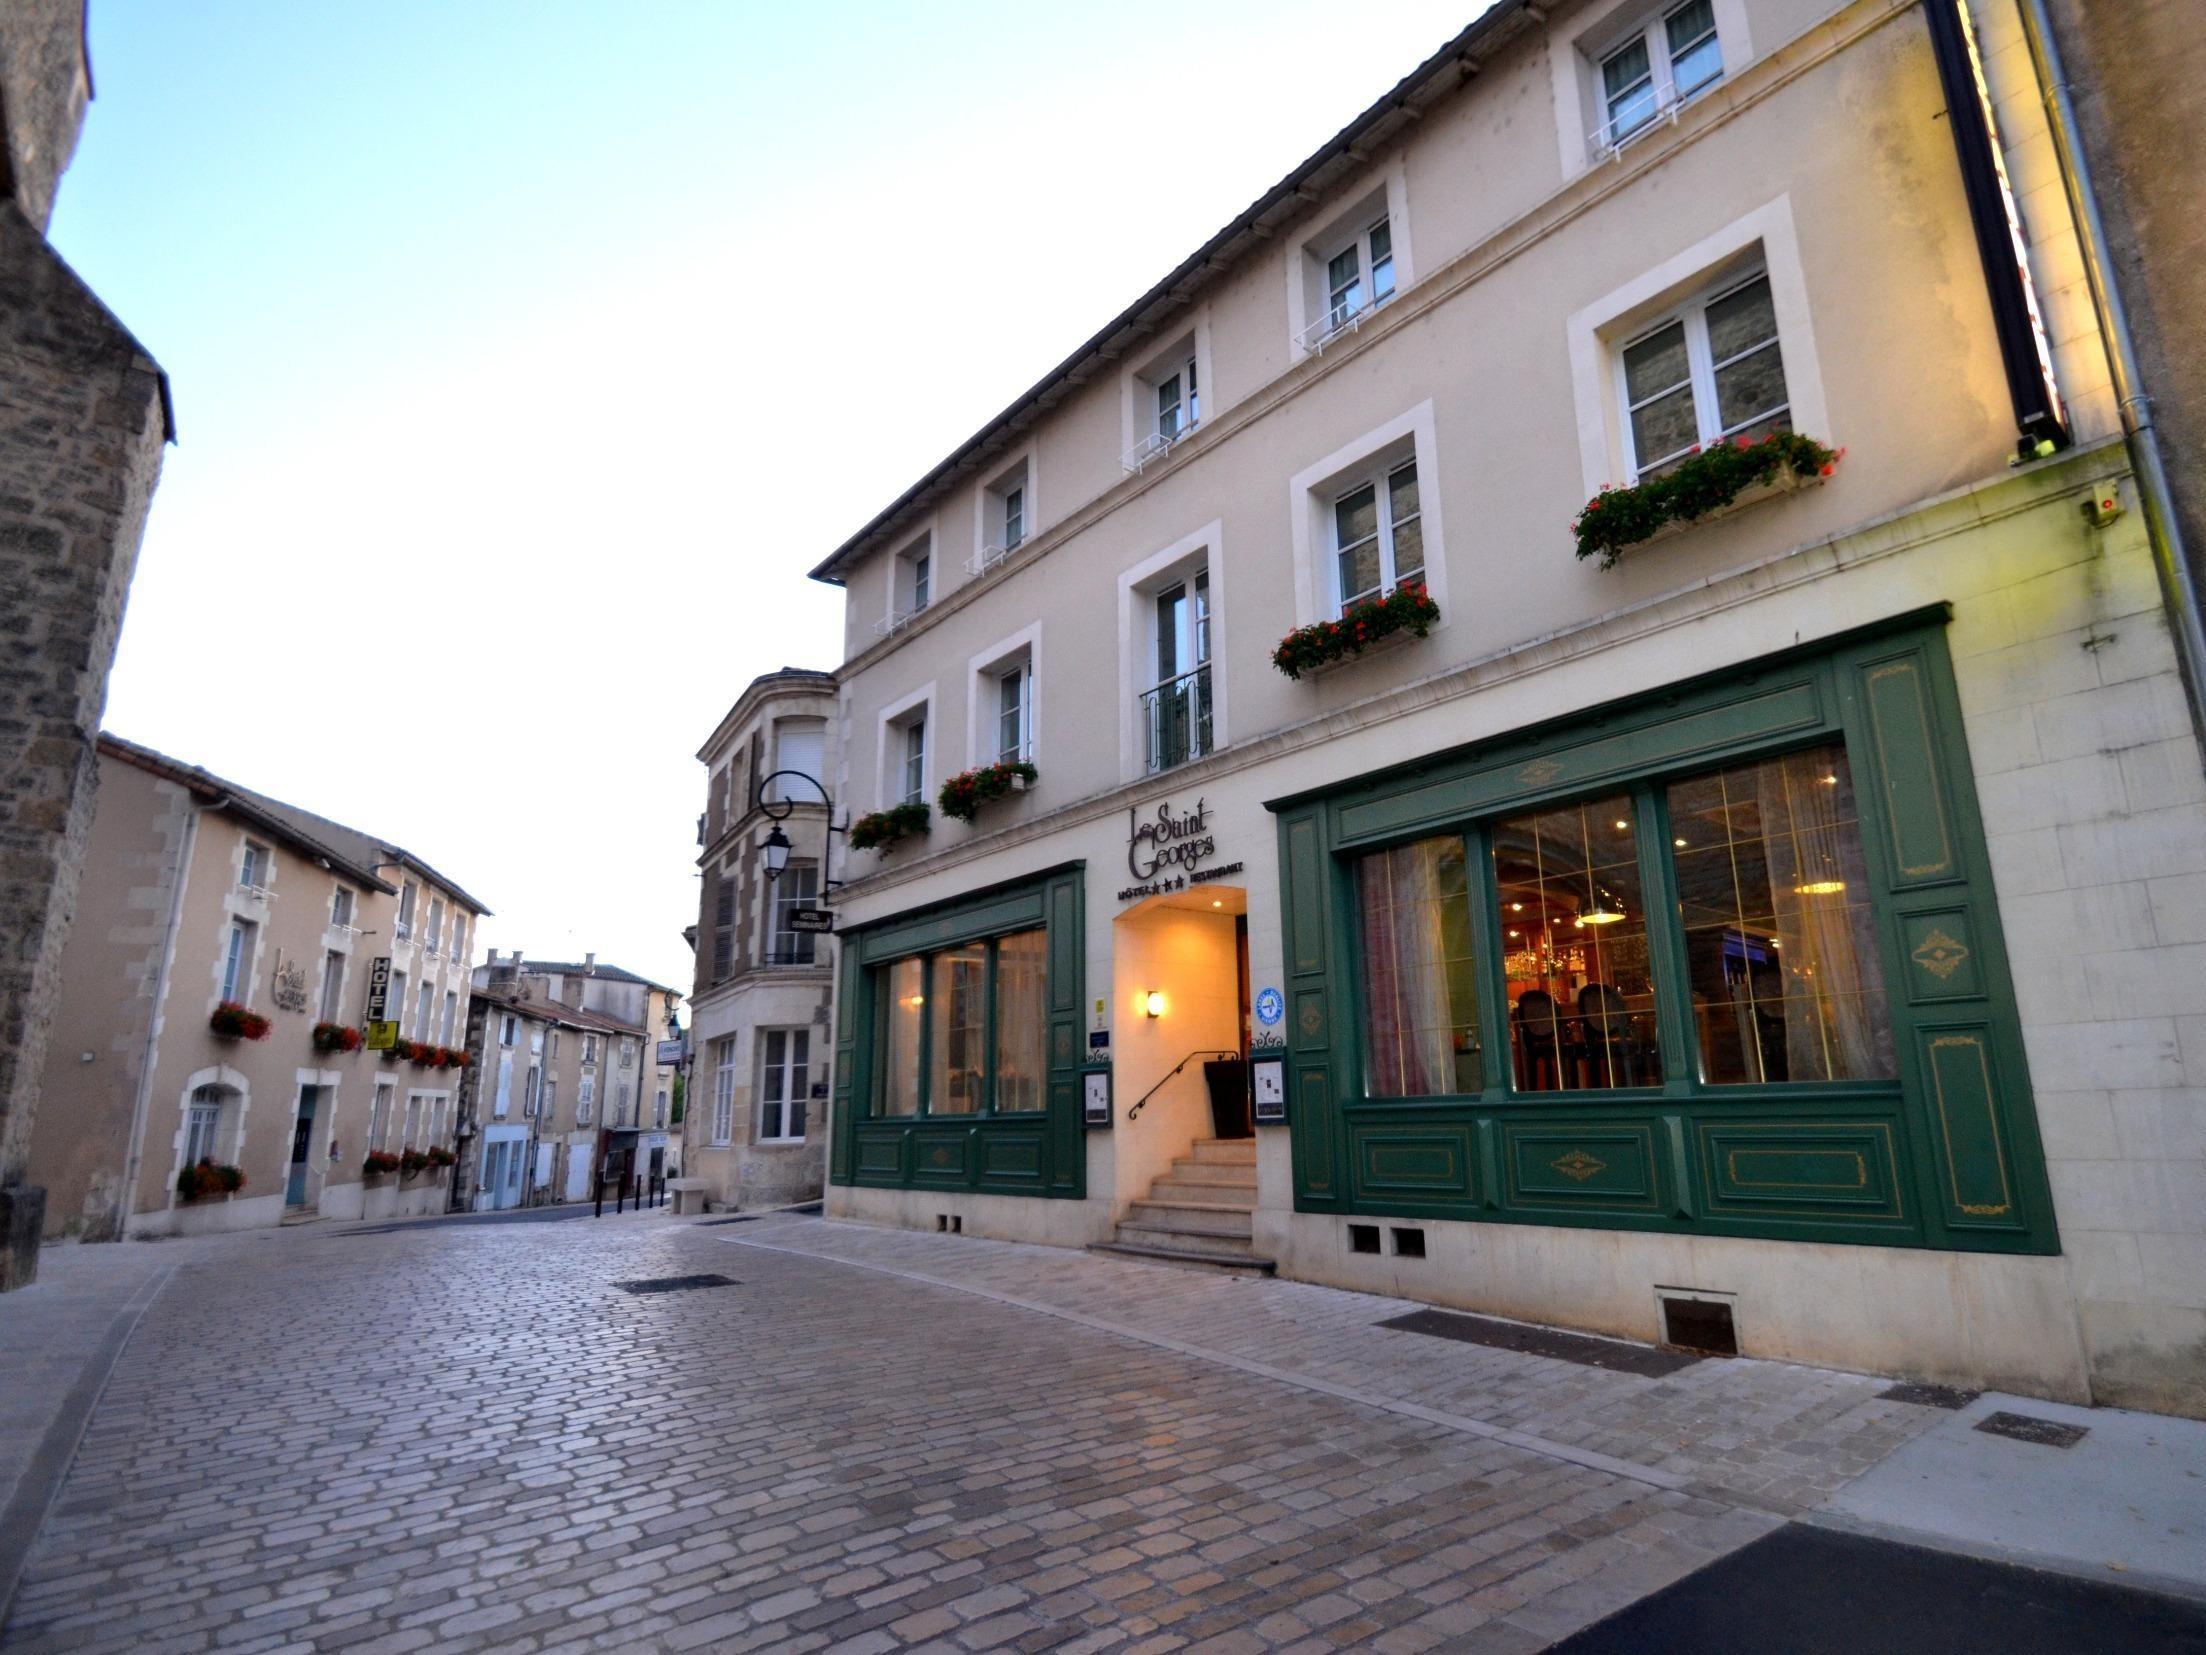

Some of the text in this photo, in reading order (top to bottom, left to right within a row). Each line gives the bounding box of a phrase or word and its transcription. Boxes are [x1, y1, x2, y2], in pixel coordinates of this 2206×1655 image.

[1154, 797, 1214, 843] Saint
[1127, 829, 1215, 880] Georges
[368, 959, 389, 1020] HOTEL
